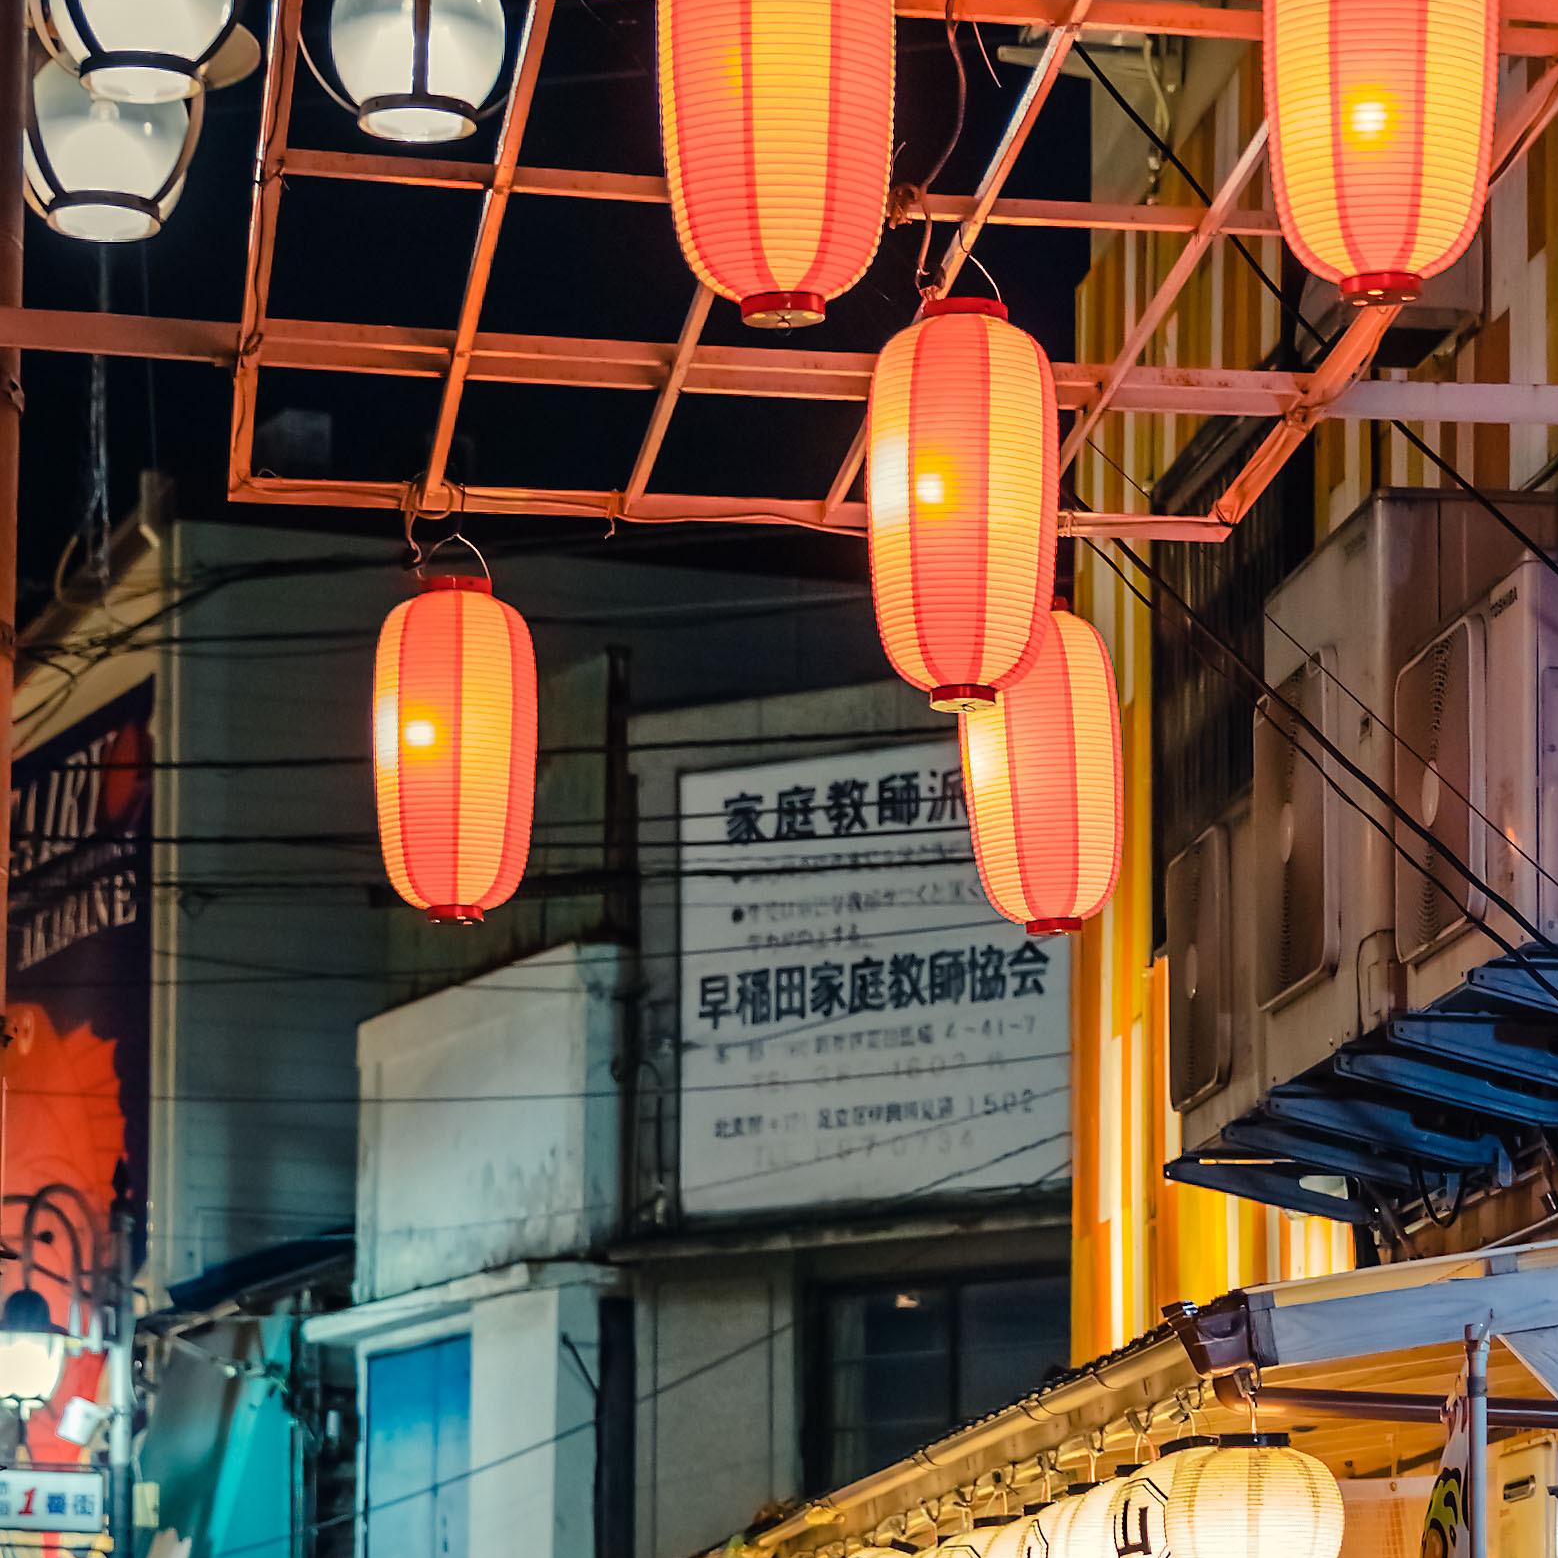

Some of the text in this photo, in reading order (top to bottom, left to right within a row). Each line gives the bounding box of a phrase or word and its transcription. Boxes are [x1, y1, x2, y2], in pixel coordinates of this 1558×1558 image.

[699, 941, 1051, 1030] 早稲田家庭教師協会
